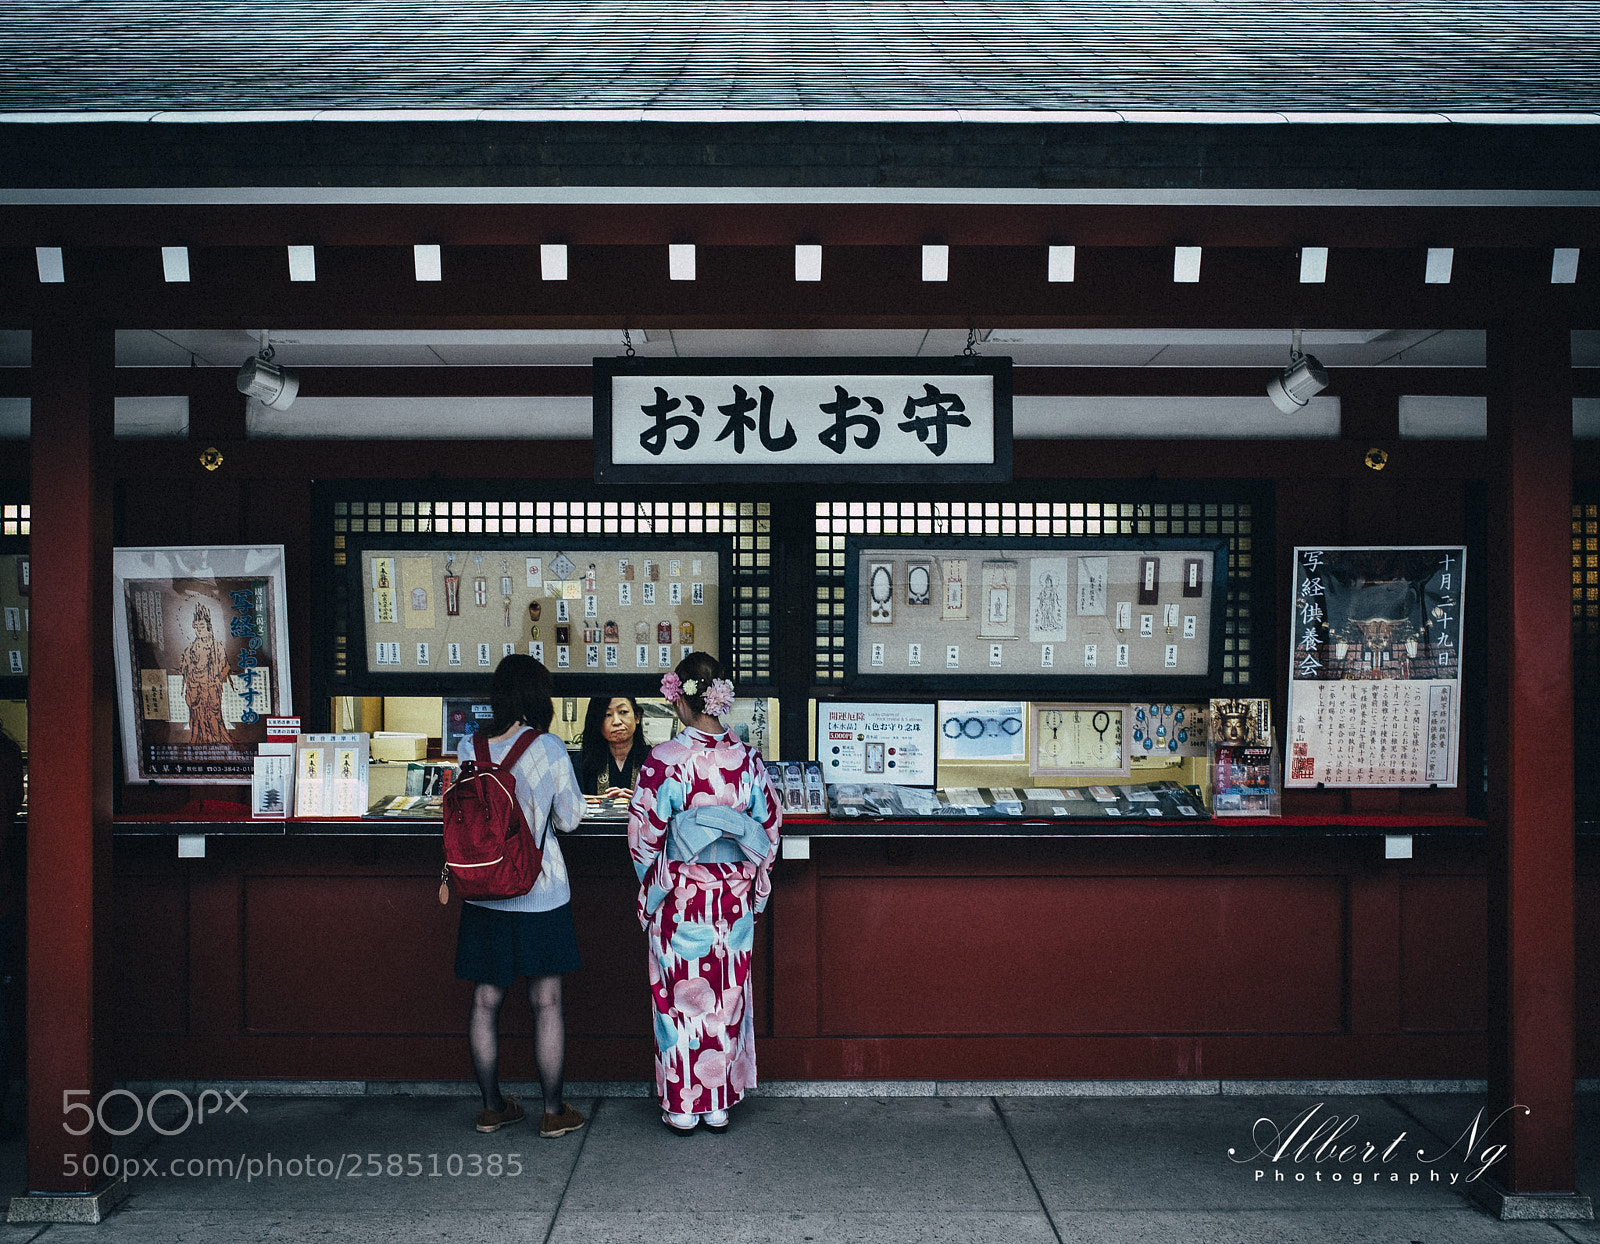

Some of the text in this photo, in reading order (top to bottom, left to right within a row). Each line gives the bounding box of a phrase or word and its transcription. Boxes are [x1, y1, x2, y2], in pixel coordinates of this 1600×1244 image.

[639, 383, 972, 457] お札お守
[1298, 551, 1326, 676] 写経供養会
[1437, 554, 1455, 666] 十月二十九日
[229, 589, 262, 724] 写経のおすすめ
[751, 697, 766, 739] 良縁守
[865, 722, 921, 731] 五色お守り念珠
[1428, 710, 1438, 779] 写経供養会のご案内
